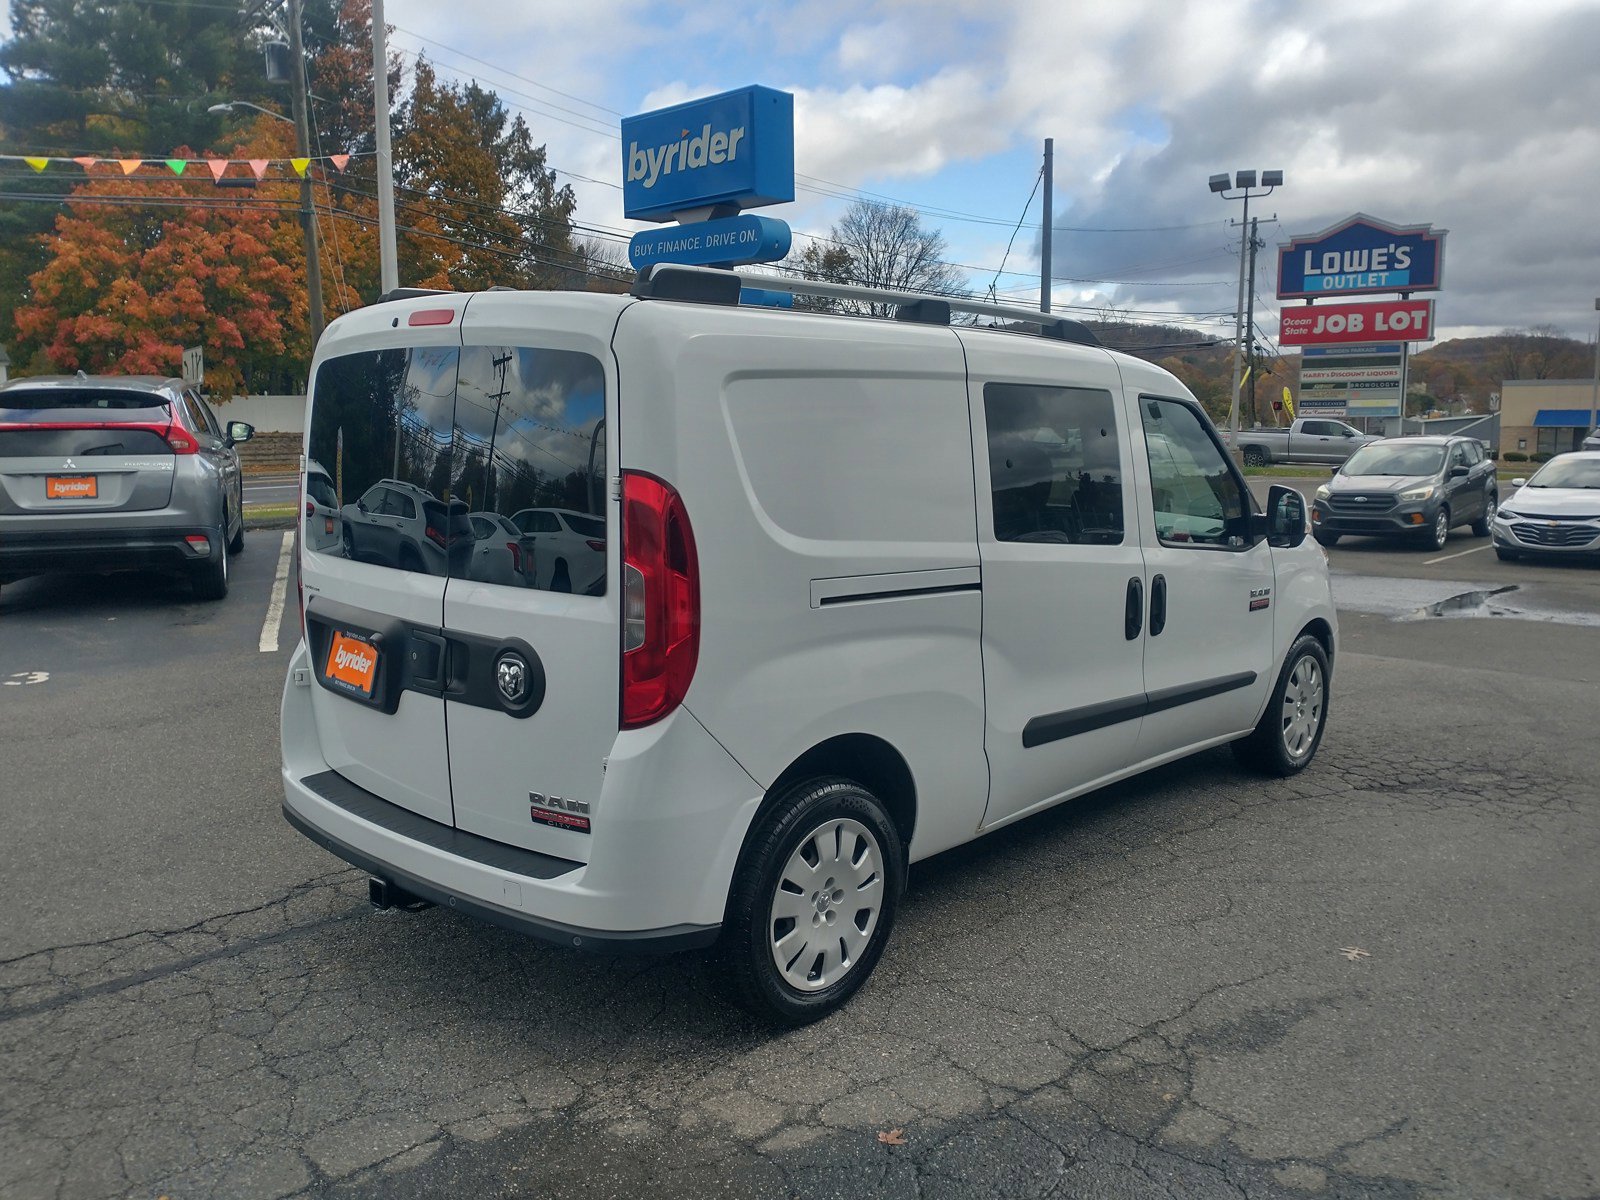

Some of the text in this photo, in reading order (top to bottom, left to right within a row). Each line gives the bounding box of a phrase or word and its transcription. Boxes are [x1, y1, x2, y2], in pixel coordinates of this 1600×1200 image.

[627, 124, 745, 189] byrider
[634, 229, 758, 257] BUY. FINANCE. DRIVE ON.
[1304, 243, 1412, 276] LOWE'S
[1323, 272, 1390, 290] OUTLET
[1283, 317, 1312, 326] Ocean
[1284, 327, 1309, 336] State
[1312, 310, 1427, 335] JOB LOT
[54, 482, 91, 493] byrider
[334, 644, 372, 674] byrider
[528, 790, 591, 815] RAM
[547, 820, 571, 829] CITY
